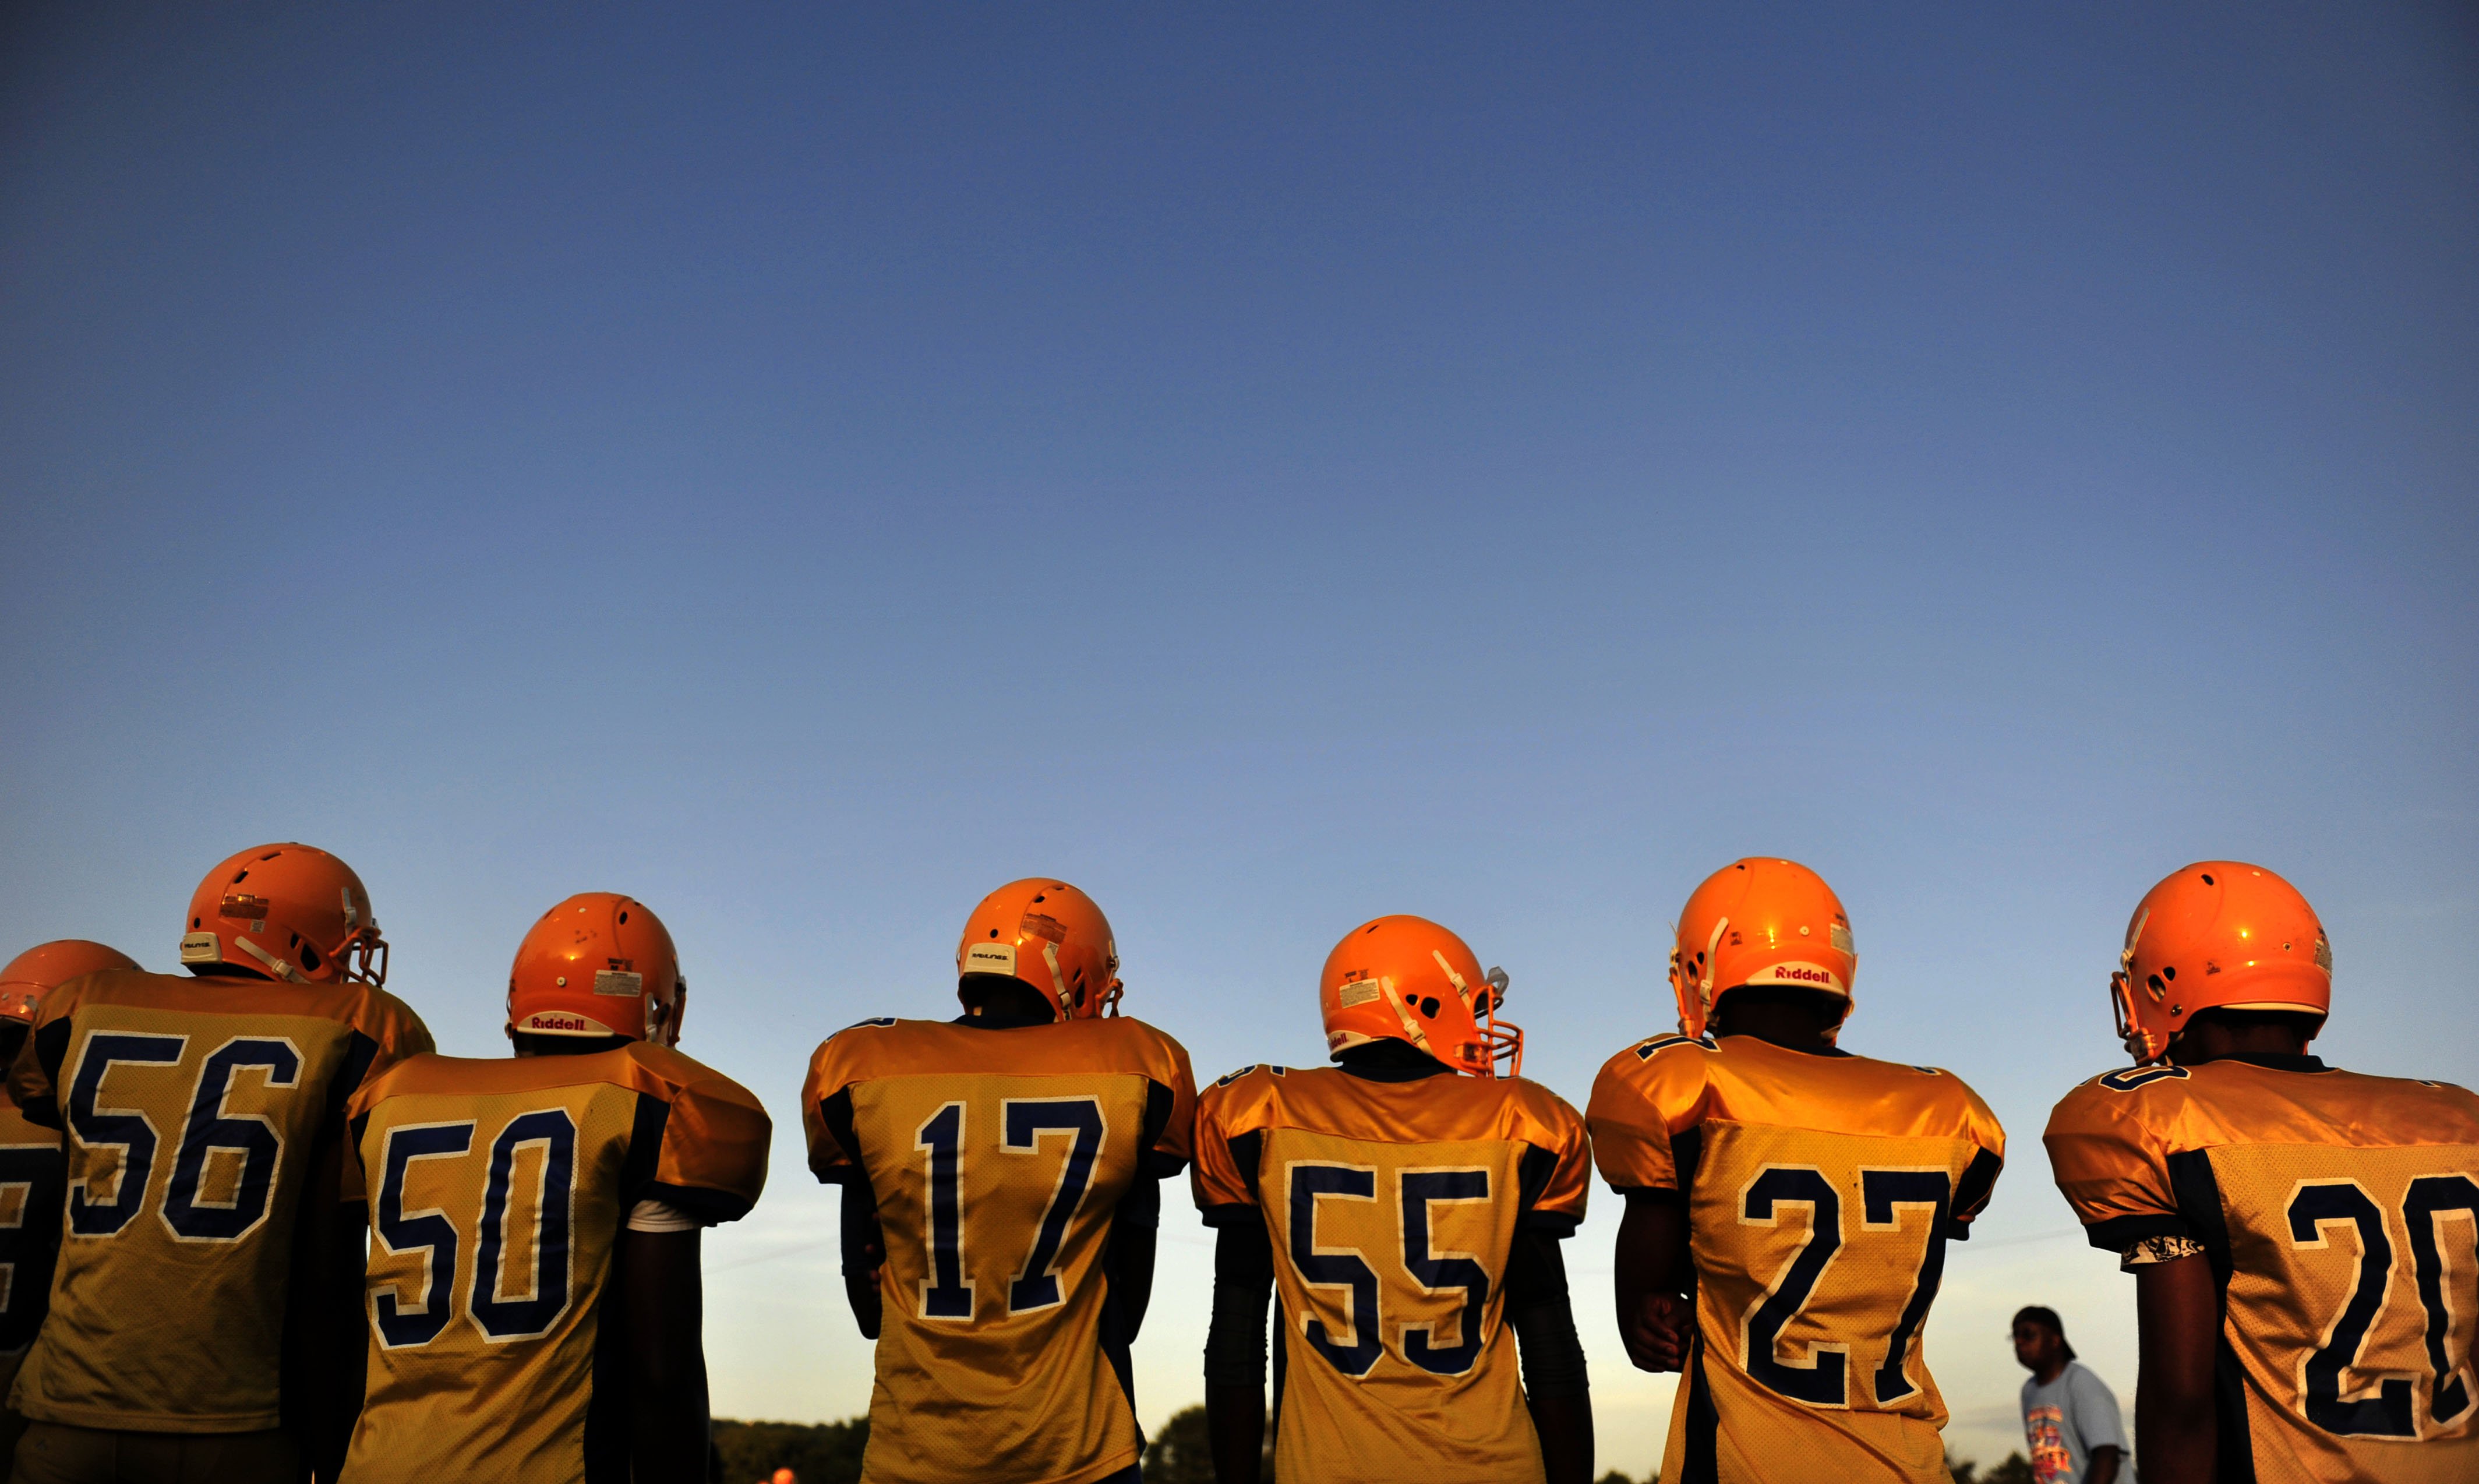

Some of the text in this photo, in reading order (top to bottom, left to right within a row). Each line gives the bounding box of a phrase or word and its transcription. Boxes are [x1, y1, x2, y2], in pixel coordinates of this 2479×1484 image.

[532, 1017, 585, 1030] Riddell
[1775, 967, 1830, 983] Riddell
[65, 1029, 305, 1243] 56
[369, 1106, 580, 1350] 50
[914, 1094, 1108, 1322] 17
[1285, 1160, 1493, 1380] 55
[1738, 1163, 1952, 1409] 27
[2284, 1171, 2479, 1442] 20
